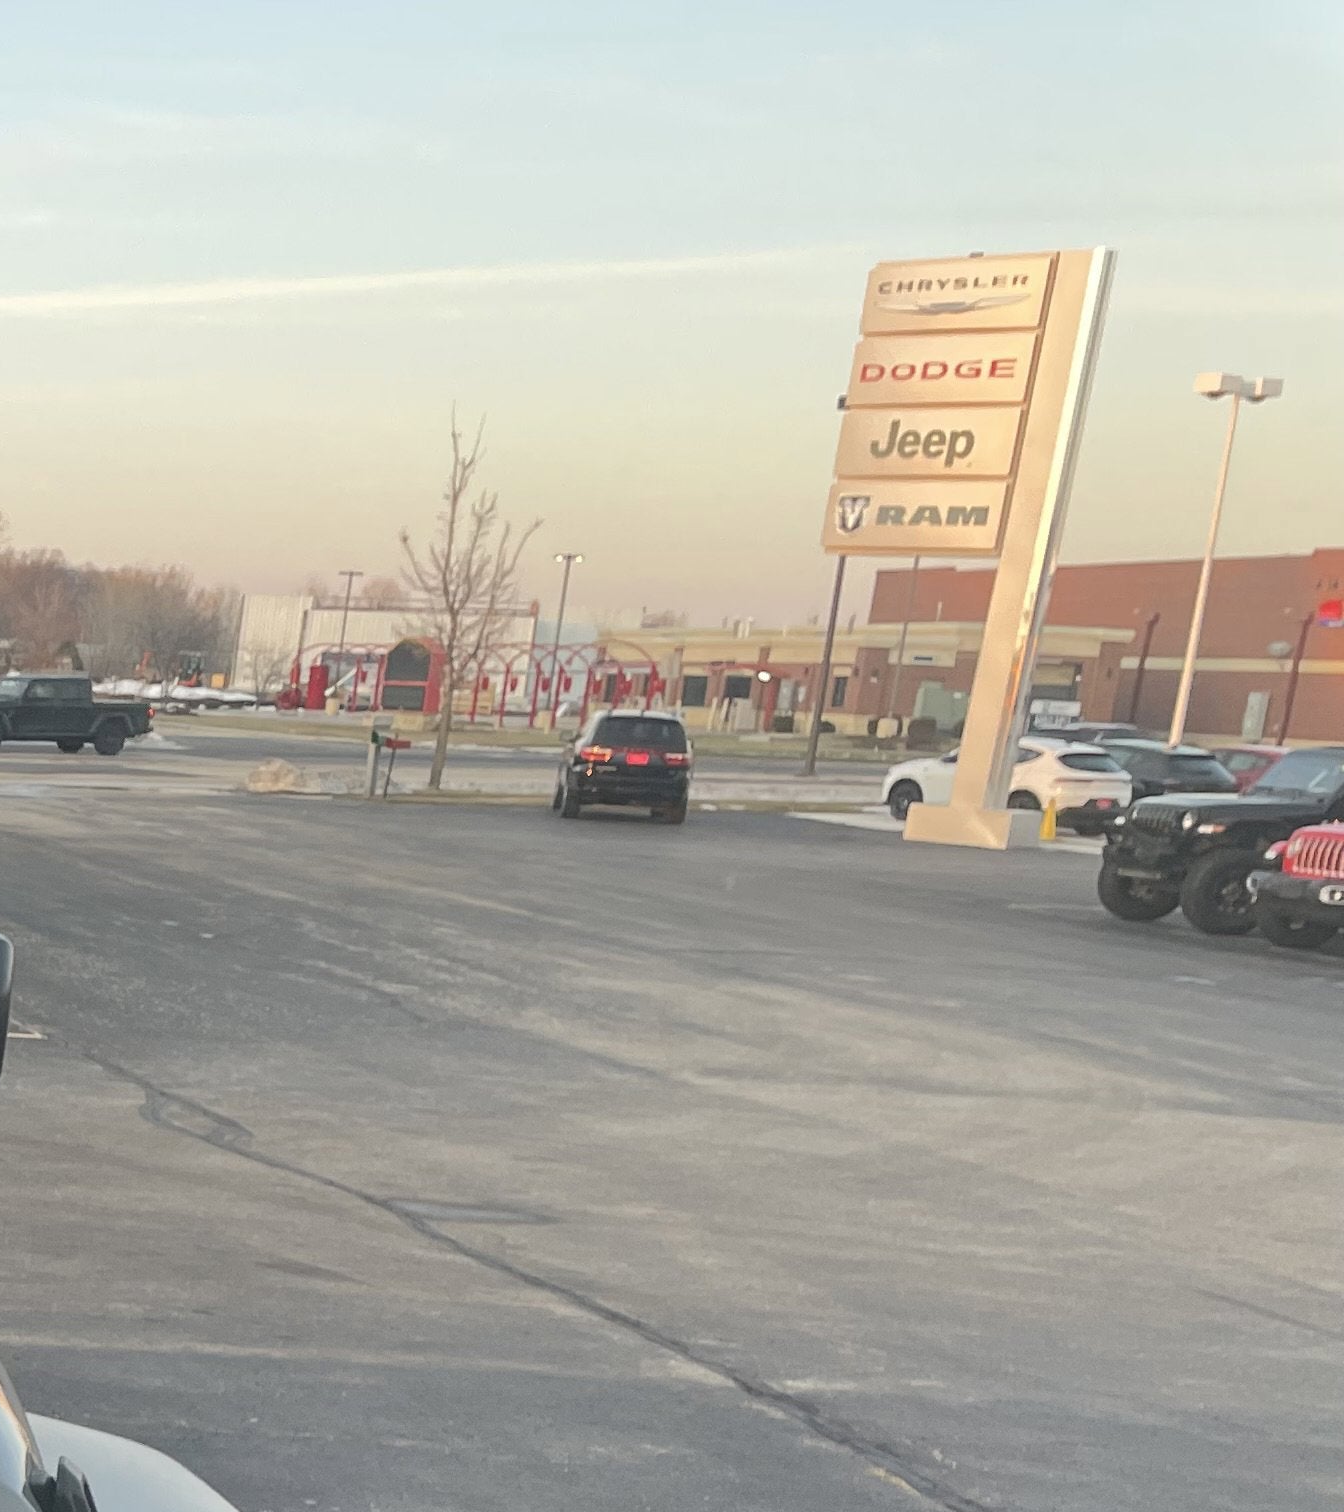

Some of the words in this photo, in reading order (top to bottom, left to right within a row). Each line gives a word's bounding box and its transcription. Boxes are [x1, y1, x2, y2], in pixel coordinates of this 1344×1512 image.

[878, 274, 1029, 295] CHRYSLER
[859, 358, 1017, 383] DODGE
[870, 419, 975, 467] Jeep
[875, 505, 989, 526] RAM
